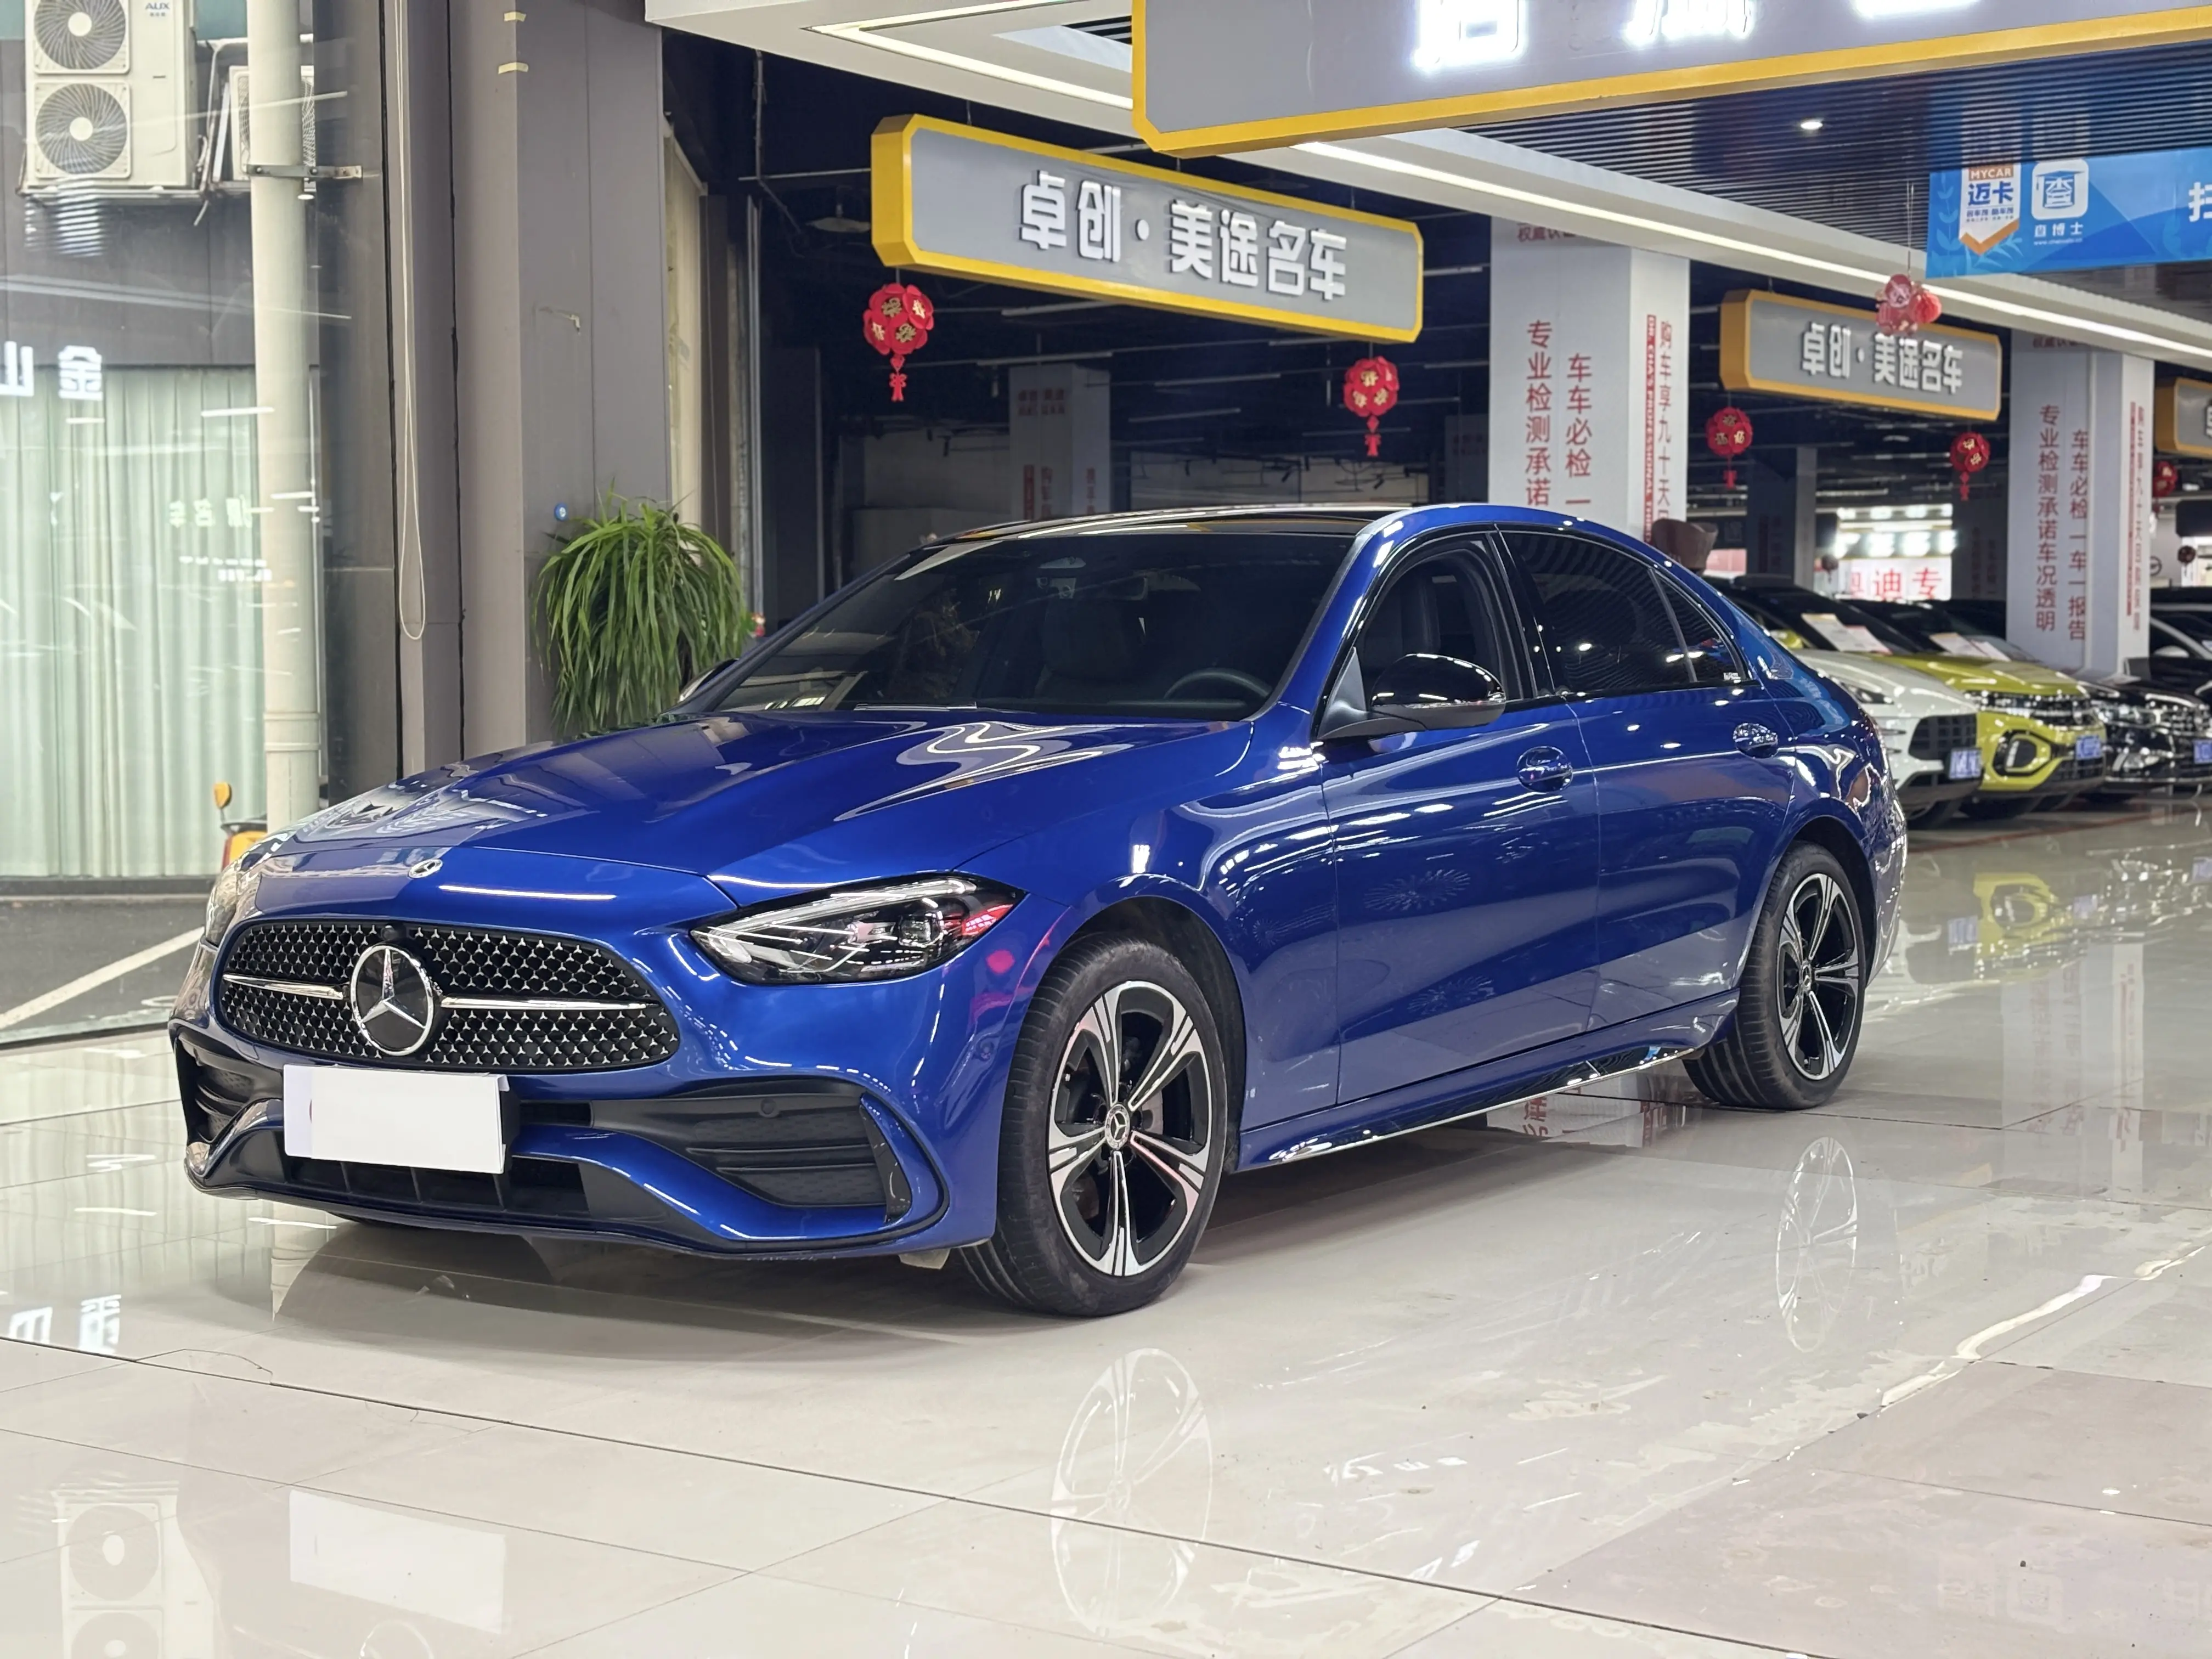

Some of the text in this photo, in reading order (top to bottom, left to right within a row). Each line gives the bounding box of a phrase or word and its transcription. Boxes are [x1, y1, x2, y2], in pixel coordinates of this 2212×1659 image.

[1968, 180, 2014, 206] 迈卡
[1971, 167, 2012, 179] MYCAR
[1021, 170, 1346, 301] 卓创·美途名车
[1516, 223, 1577, 242] 权威认
[1802, 322, 1963, 394] 卓创·美途名车
[1525, 320, 1552, 506] 专业检测承诺
[1566, 353, 1592, 504] 车车必检一
[2036, 404, 2061, 632] 专业检测承诺车况透明
